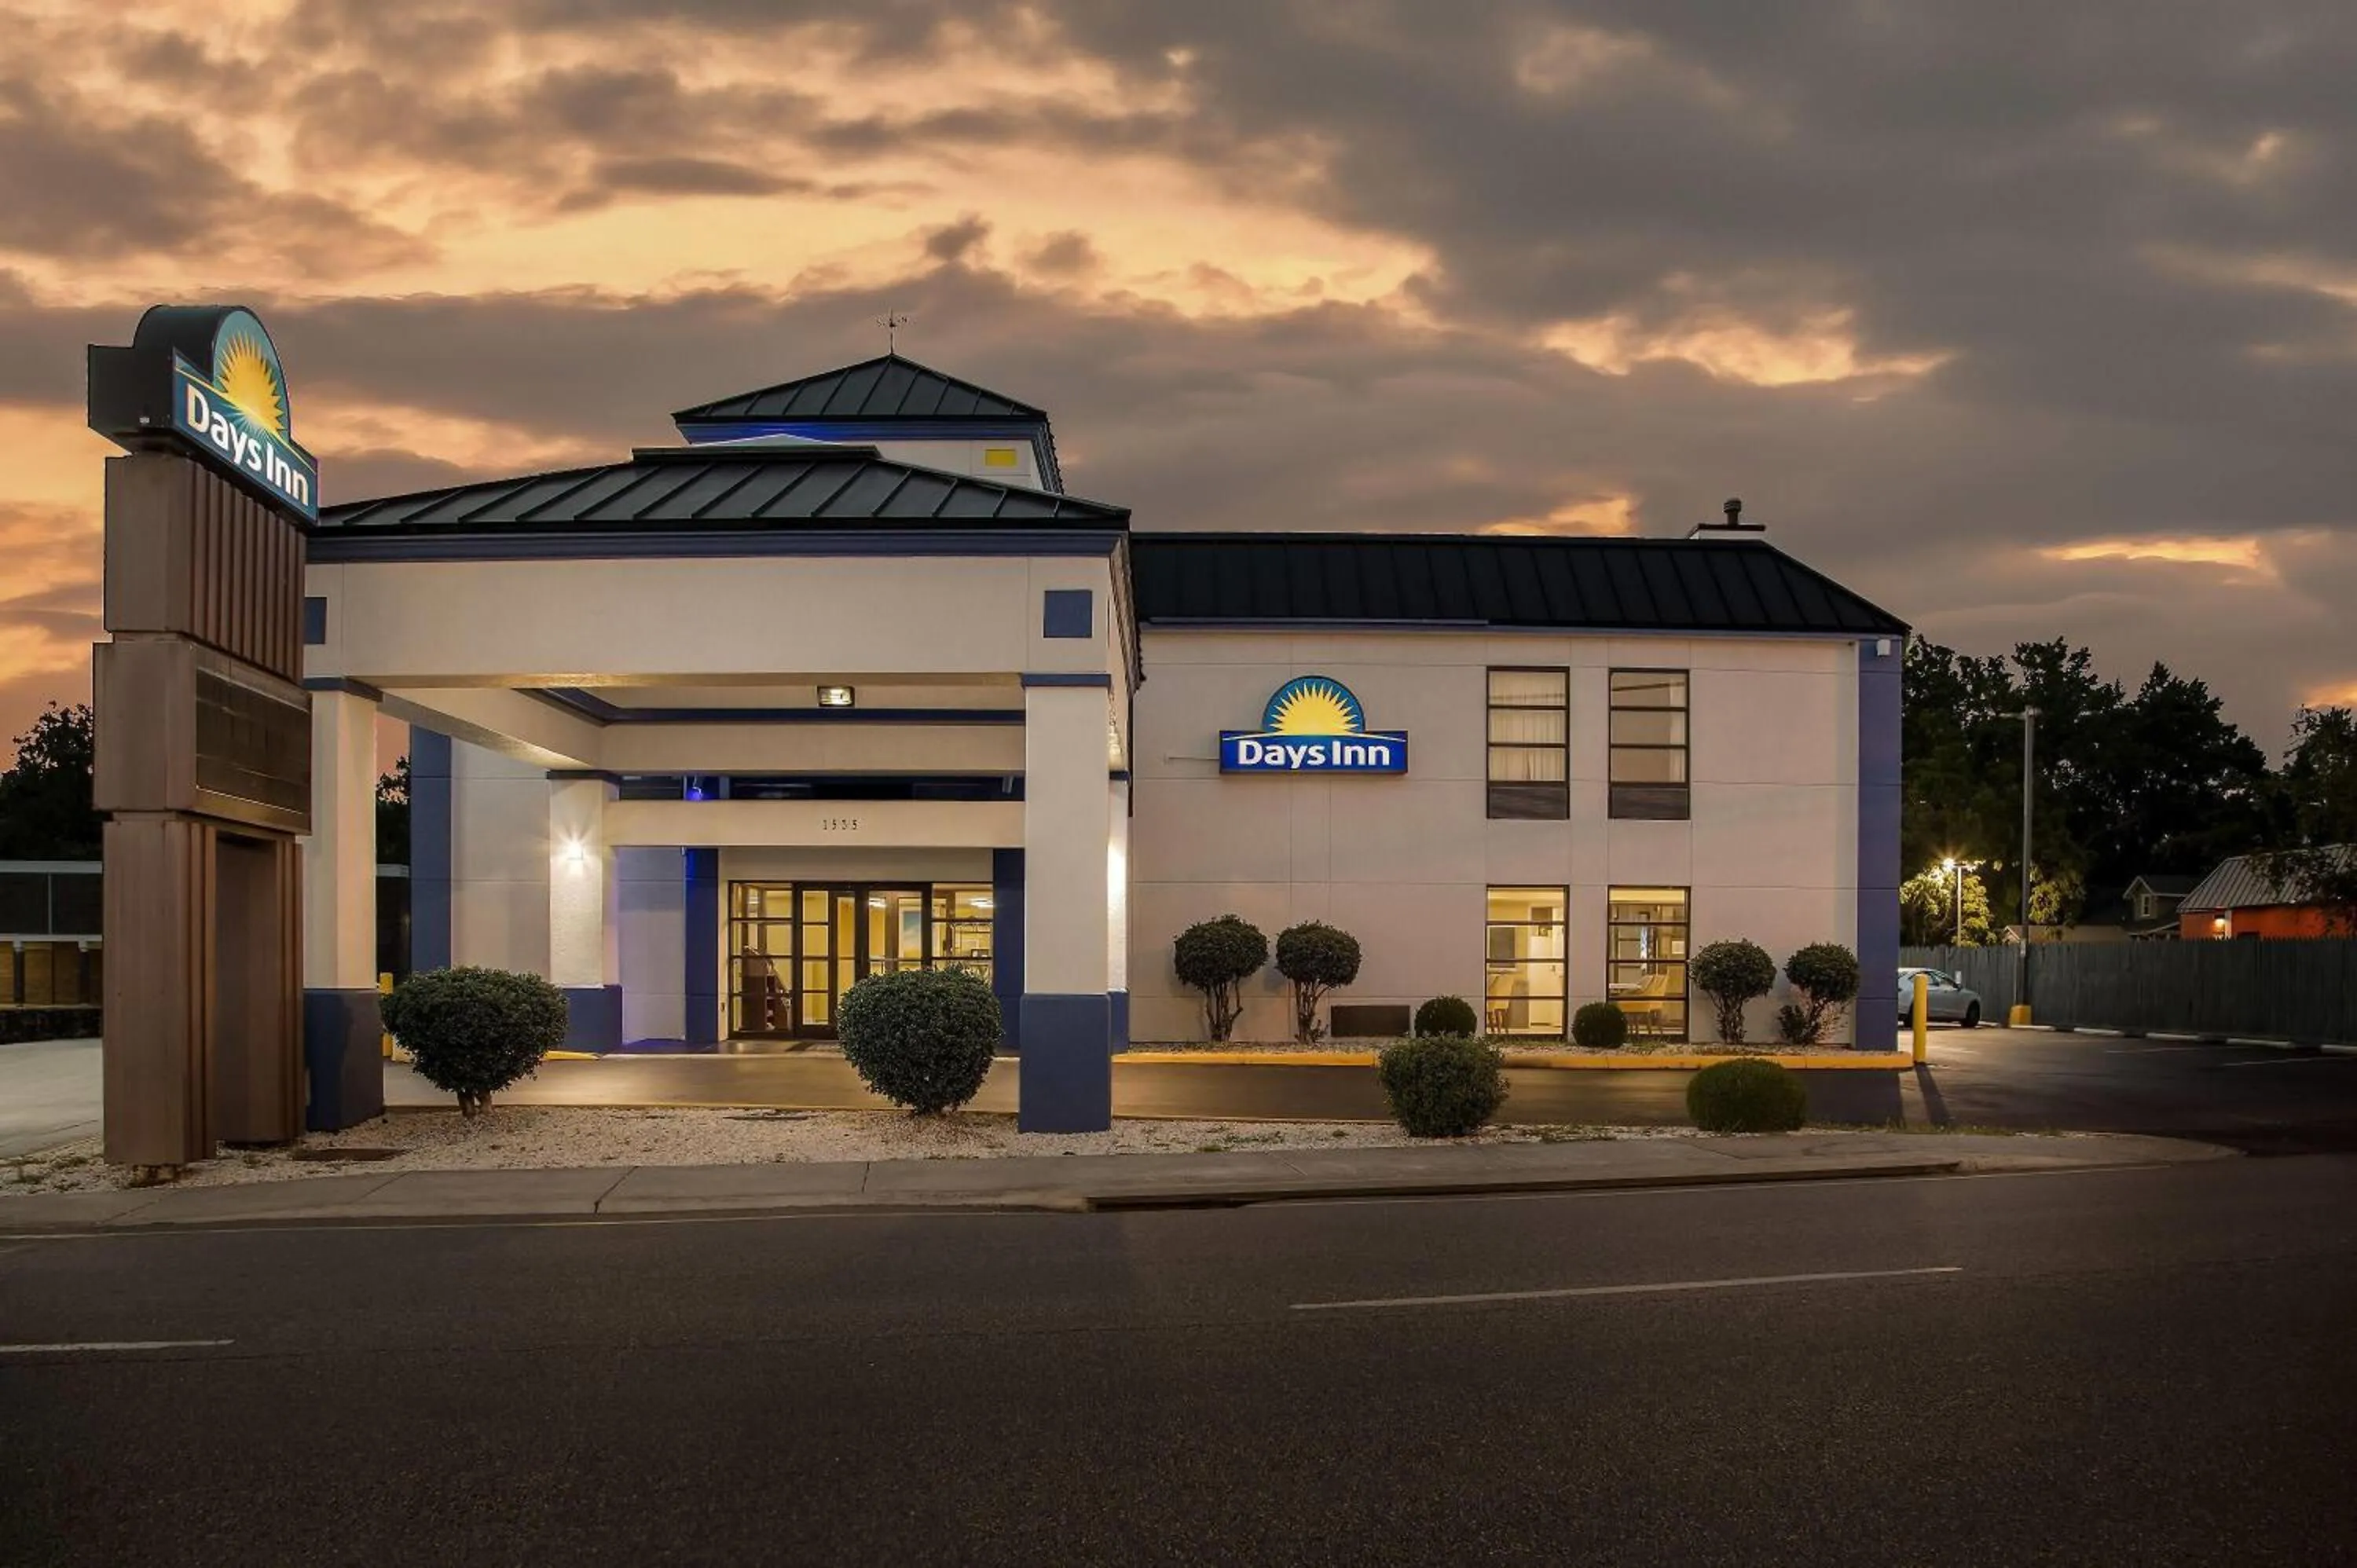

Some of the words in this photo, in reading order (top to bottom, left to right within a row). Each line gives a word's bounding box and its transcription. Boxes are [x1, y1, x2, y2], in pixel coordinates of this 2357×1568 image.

[187, 383, 262, 472] Days
[266, 442, 309, 506] Inn
[1237, 740, 1326, 769] Days
[1332, 741, 1390, 766] Inn
